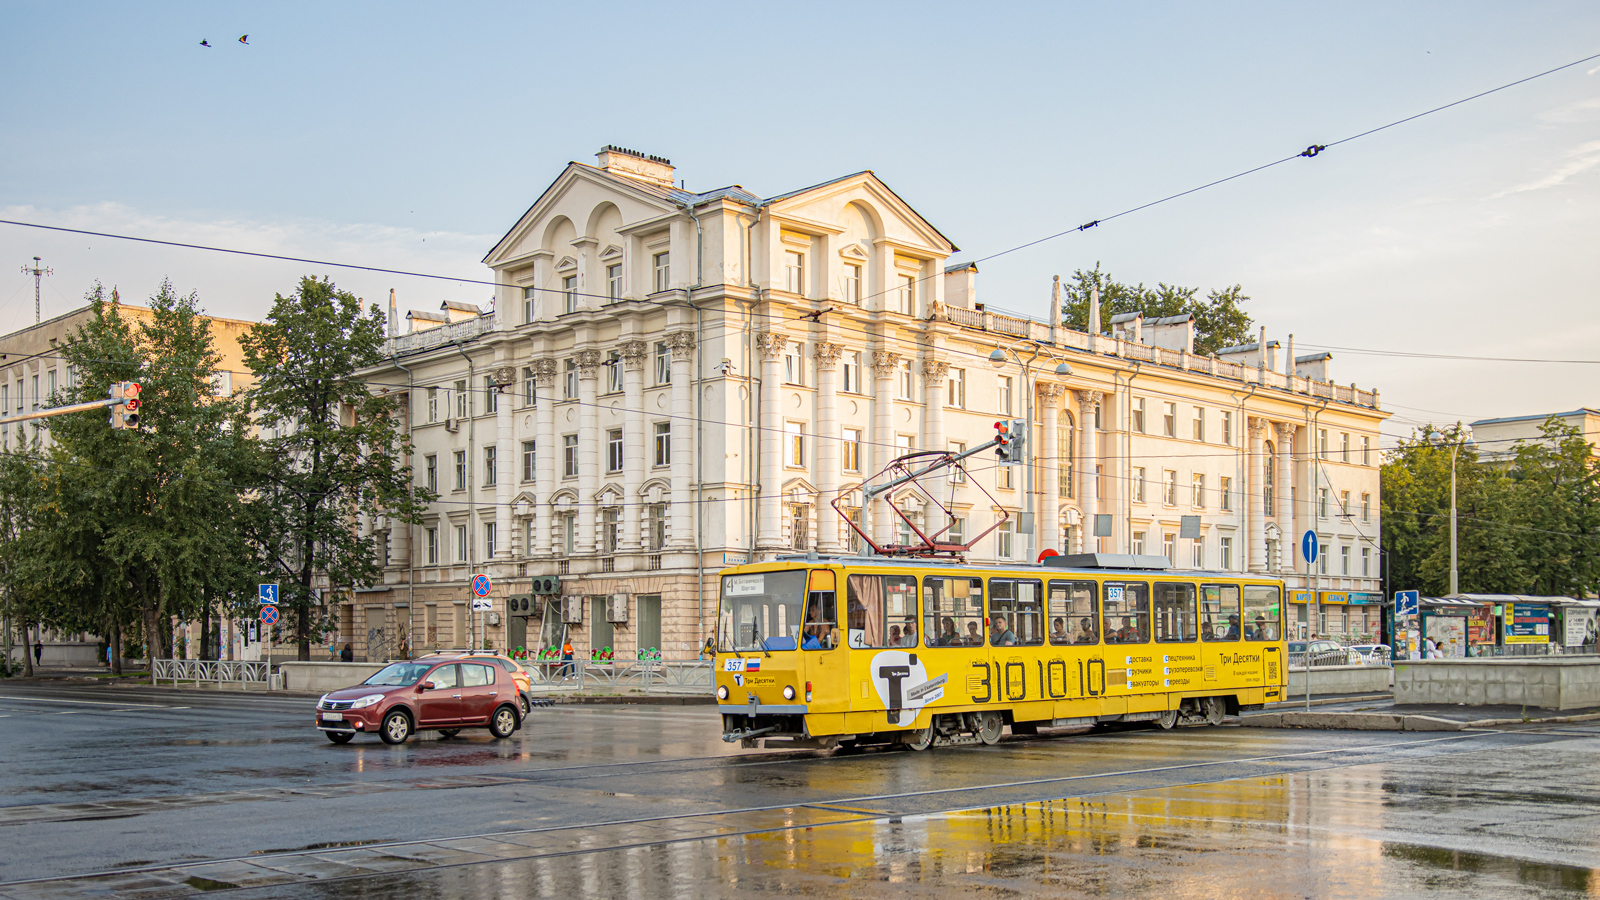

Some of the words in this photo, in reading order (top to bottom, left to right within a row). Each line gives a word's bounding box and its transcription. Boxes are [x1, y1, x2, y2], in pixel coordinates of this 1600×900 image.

[726, 578, 734, 593] 4
[1109, 587, 1122, 598] 357
[854, 632, 863, 647] 4
[1127, 656, 1152, 664] доставка
[1219, 652, 1232, 666] Три
[1233, 652, 1260, 666] Десятки
[727, 661, 742, 671] 357
[1166, 666, 1203, 674] грузоперевозки
[1128, 668, 1152, 676] грузчики
[744, 677, 753, 685] Три
[754, 677, 775, 685] Десятки
[1129, 680, 1159, 688] эвакуаторы
[1166, 678, 1190, 686] переезды
[924, 696, 934, 704] Since
